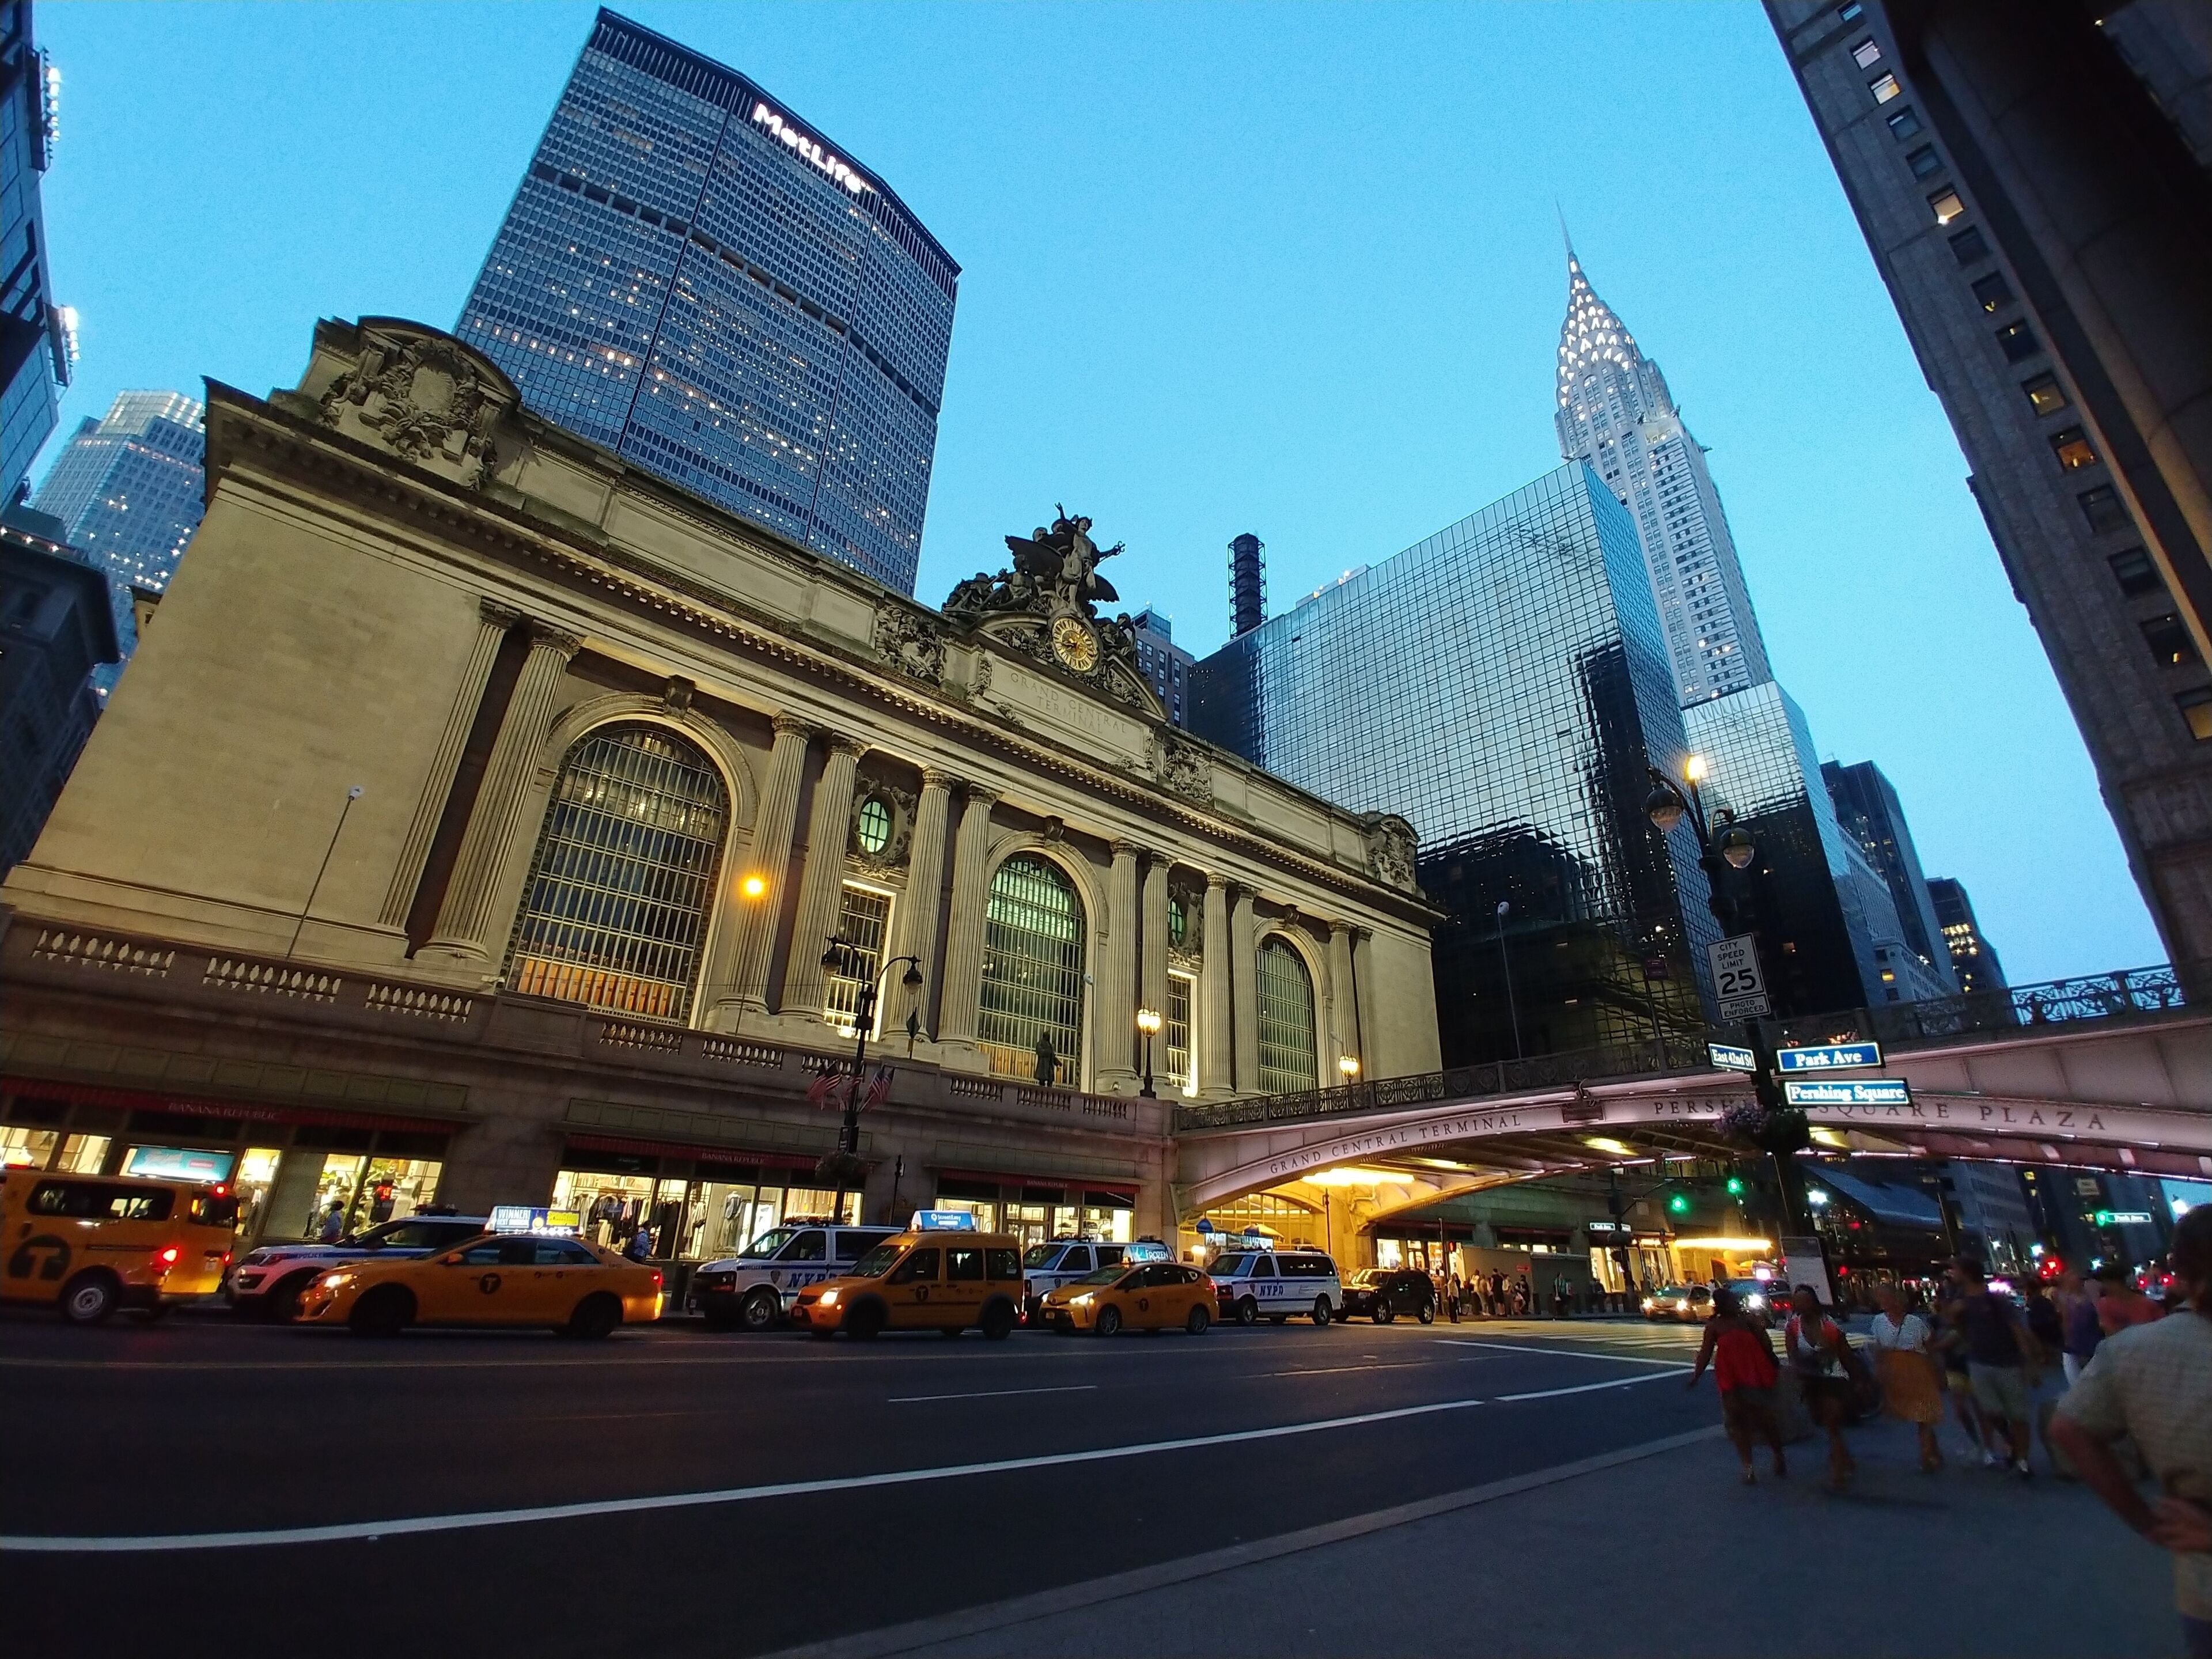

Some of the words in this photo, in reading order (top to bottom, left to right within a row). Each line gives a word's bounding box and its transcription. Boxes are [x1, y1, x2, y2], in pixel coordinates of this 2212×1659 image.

[753, 103, 861, 193] MetLife
[1010, 673, 1059, 701] GRAND
[1069, 700, 1125, 733] CENTRAL
[1037, 695, 1103, 734] TERMINAL
[1719, 941, 1738, 951] CITY
[1717, 949, 1745, 961] SPEED
[1722, 959, 1743, 969] LIMIT
[1719, 968, 1756, 995] 25
[1724, 1005, 1764, 1017] ENFORCED
[1730, 999, 1755, 1009] PHOTO
[1711, 1049, 1728, 1063] East
[1728, 1051, 1745, 1066] 42nd
[1744, 1054, 1753, 1067] St
[1794, 1052, 1831, 1067] Park
[1833, 1051, 1862, 1065] Ave
[1790, 1085, 1853, 1101] Pershing
[1854, 1085, 1906, 1101] Square
[1654, 1100, 1733, 1115] PERSH
[1979, 1105, 2105, 1130] PLAZA
[1270, 1152, 1321, 1174] GRAND
[1332, 1131, 1407, 1157] CENTRAL
[1419, 1114, 1521, 1139] TERMINAL
[702, 1152, 732, 1162] BANANA
[733, 1157, 765, 1165] REPUBLIC
[498, 1209, 531, 1219] WINNER!
[1145, 1249, 1168, 1260] FROZEN
[1259, 1285, 1285, 1296] NYPD
